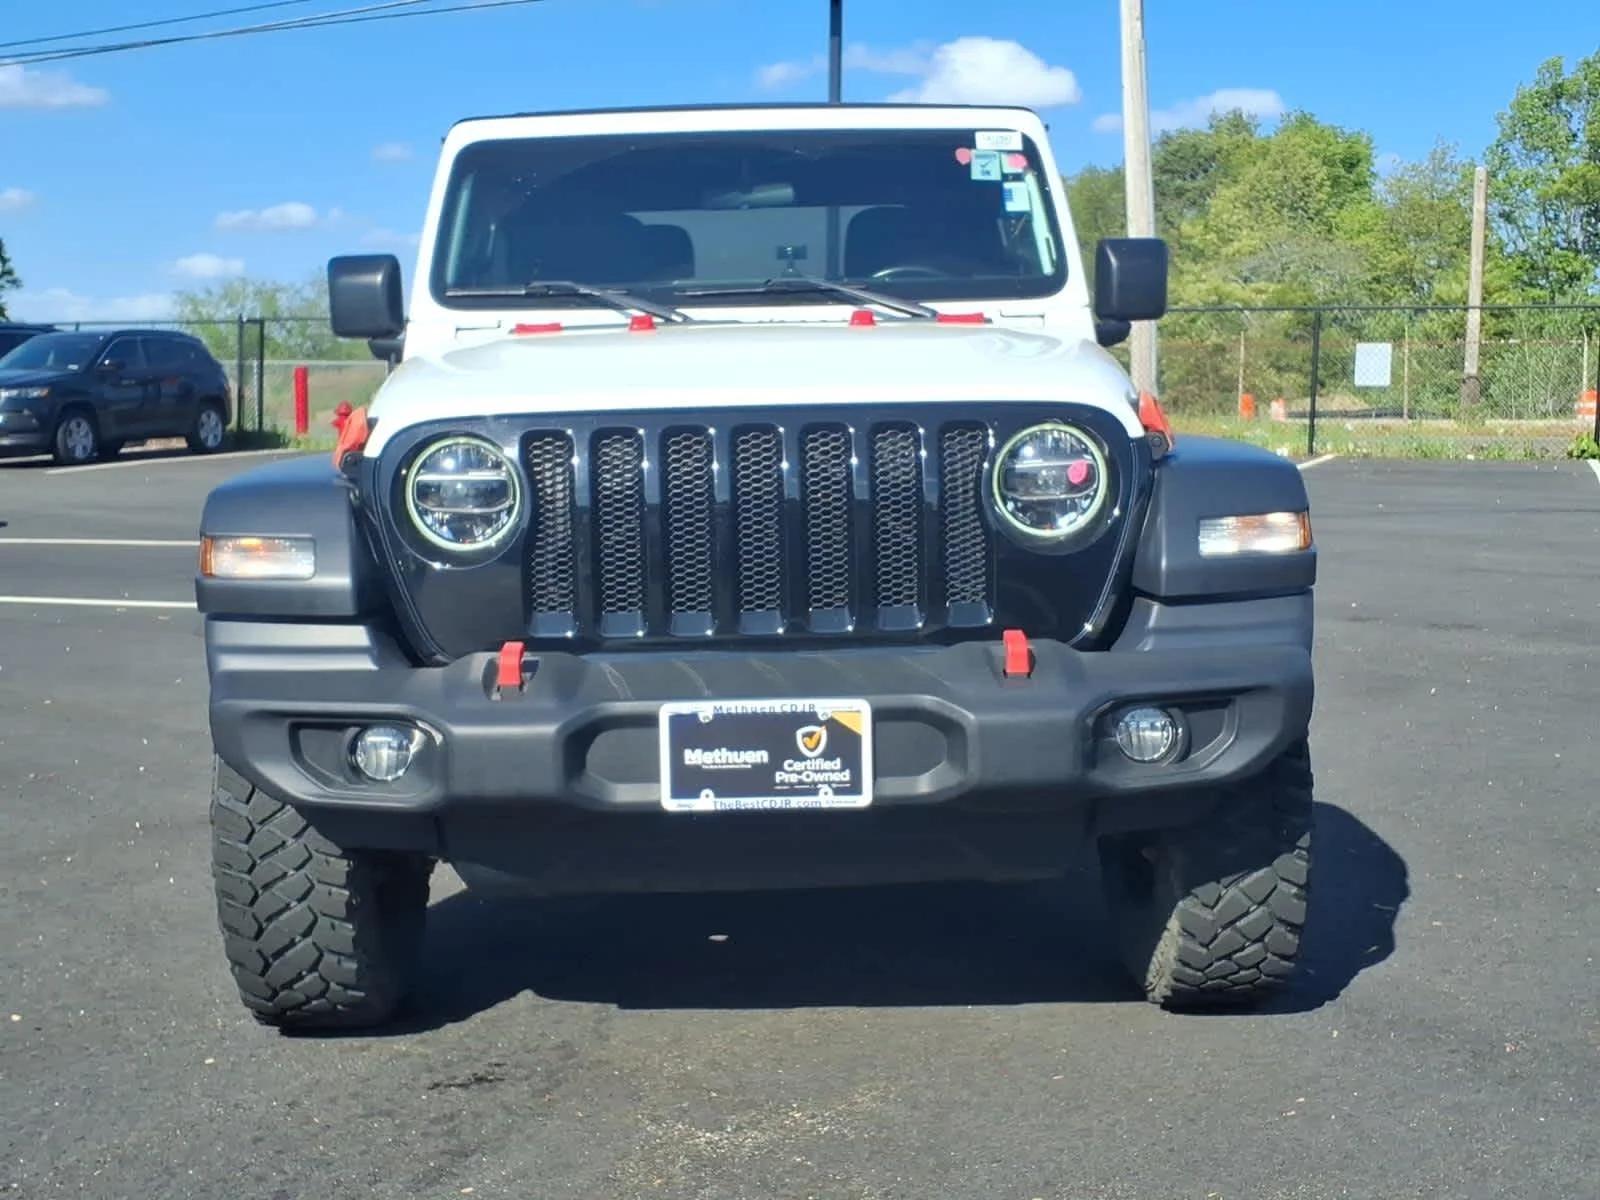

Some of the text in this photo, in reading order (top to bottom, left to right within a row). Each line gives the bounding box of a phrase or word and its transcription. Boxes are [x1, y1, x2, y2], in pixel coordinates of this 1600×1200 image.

[783, 757, 841, 772] Certified
[775, 769, 850, 784] Pre-Owned
[712, 798, 822, 810] TheBestCDJR.com
